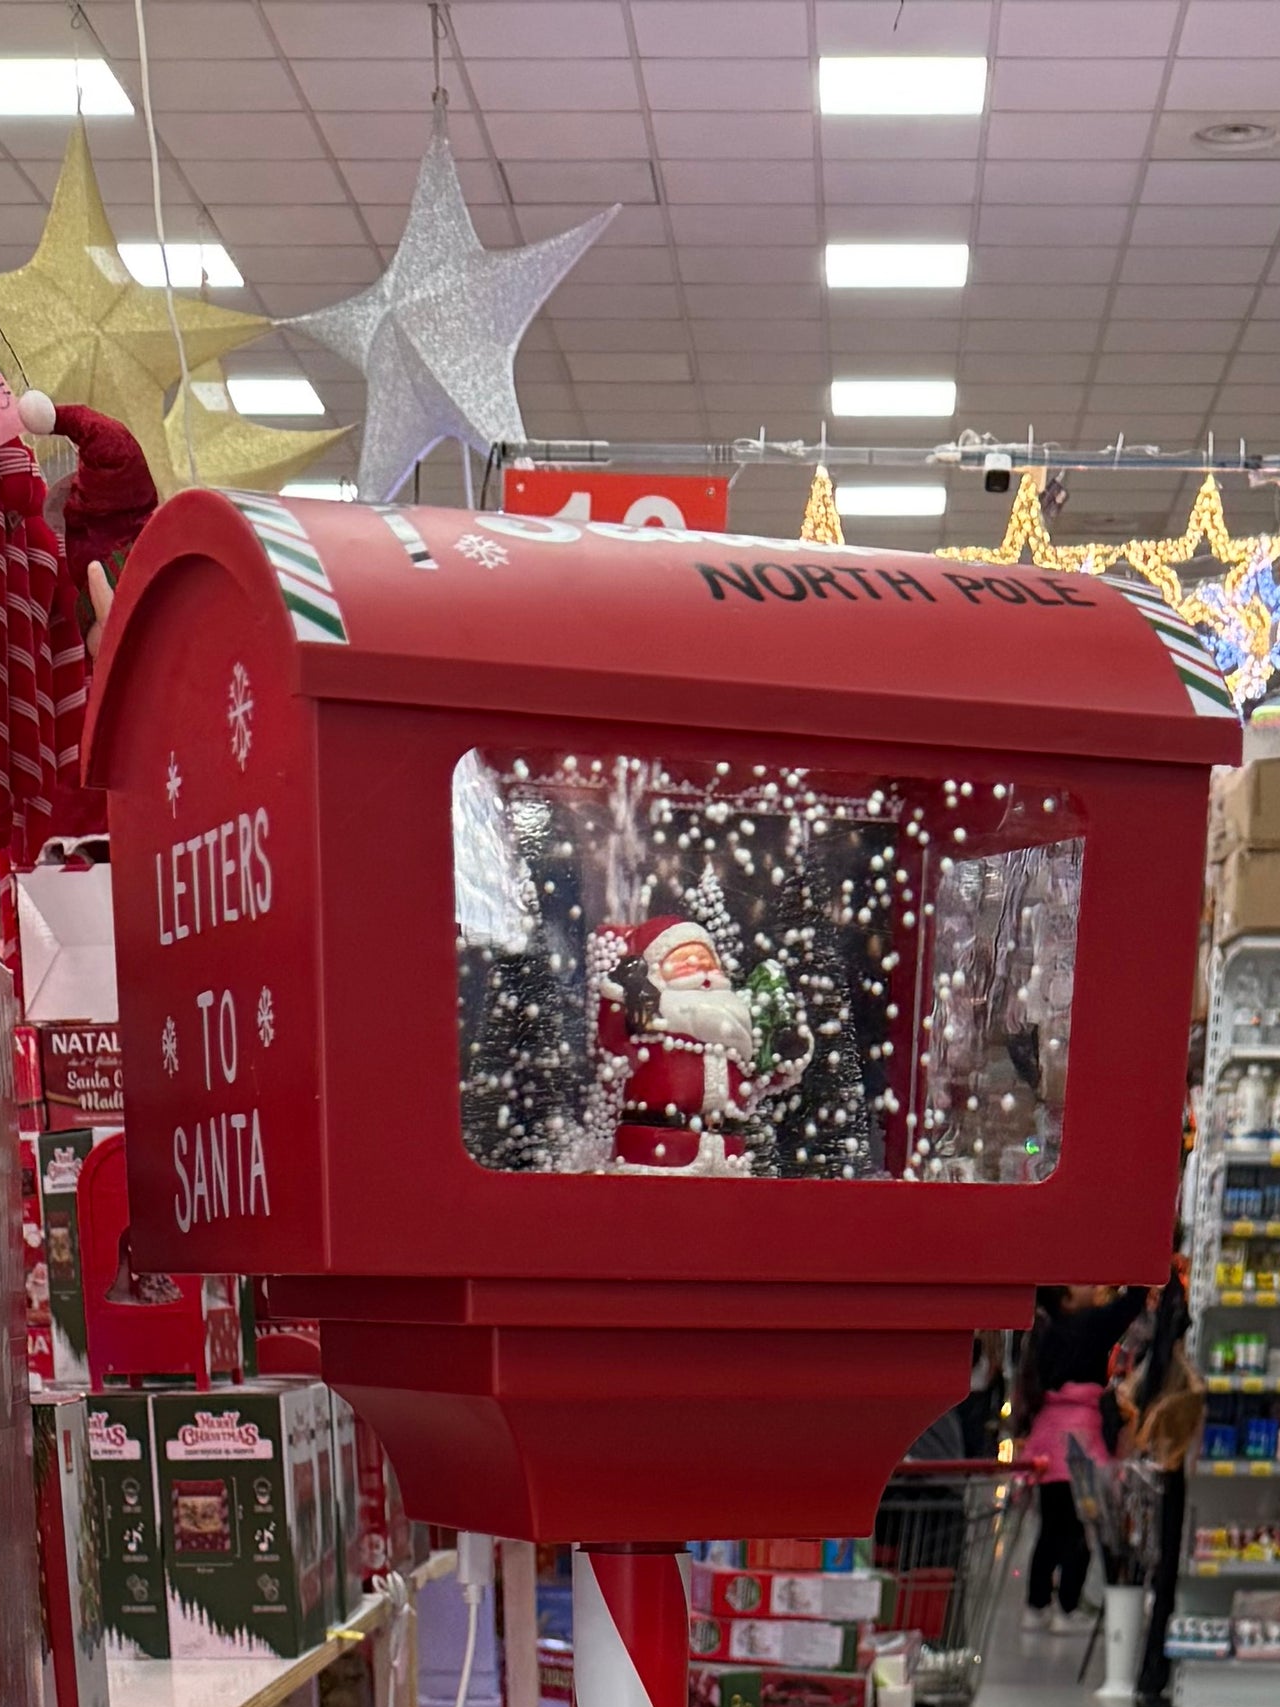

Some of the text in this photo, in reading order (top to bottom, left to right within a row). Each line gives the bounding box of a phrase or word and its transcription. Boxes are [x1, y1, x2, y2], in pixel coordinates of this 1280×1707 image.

[695, 560, 1098, 608] NORTH POLE
[155, 806, 273, 947] LETTERS
[197, 987, 238, 1092] TO
[173, 1106, 271, 1235] SANTA
